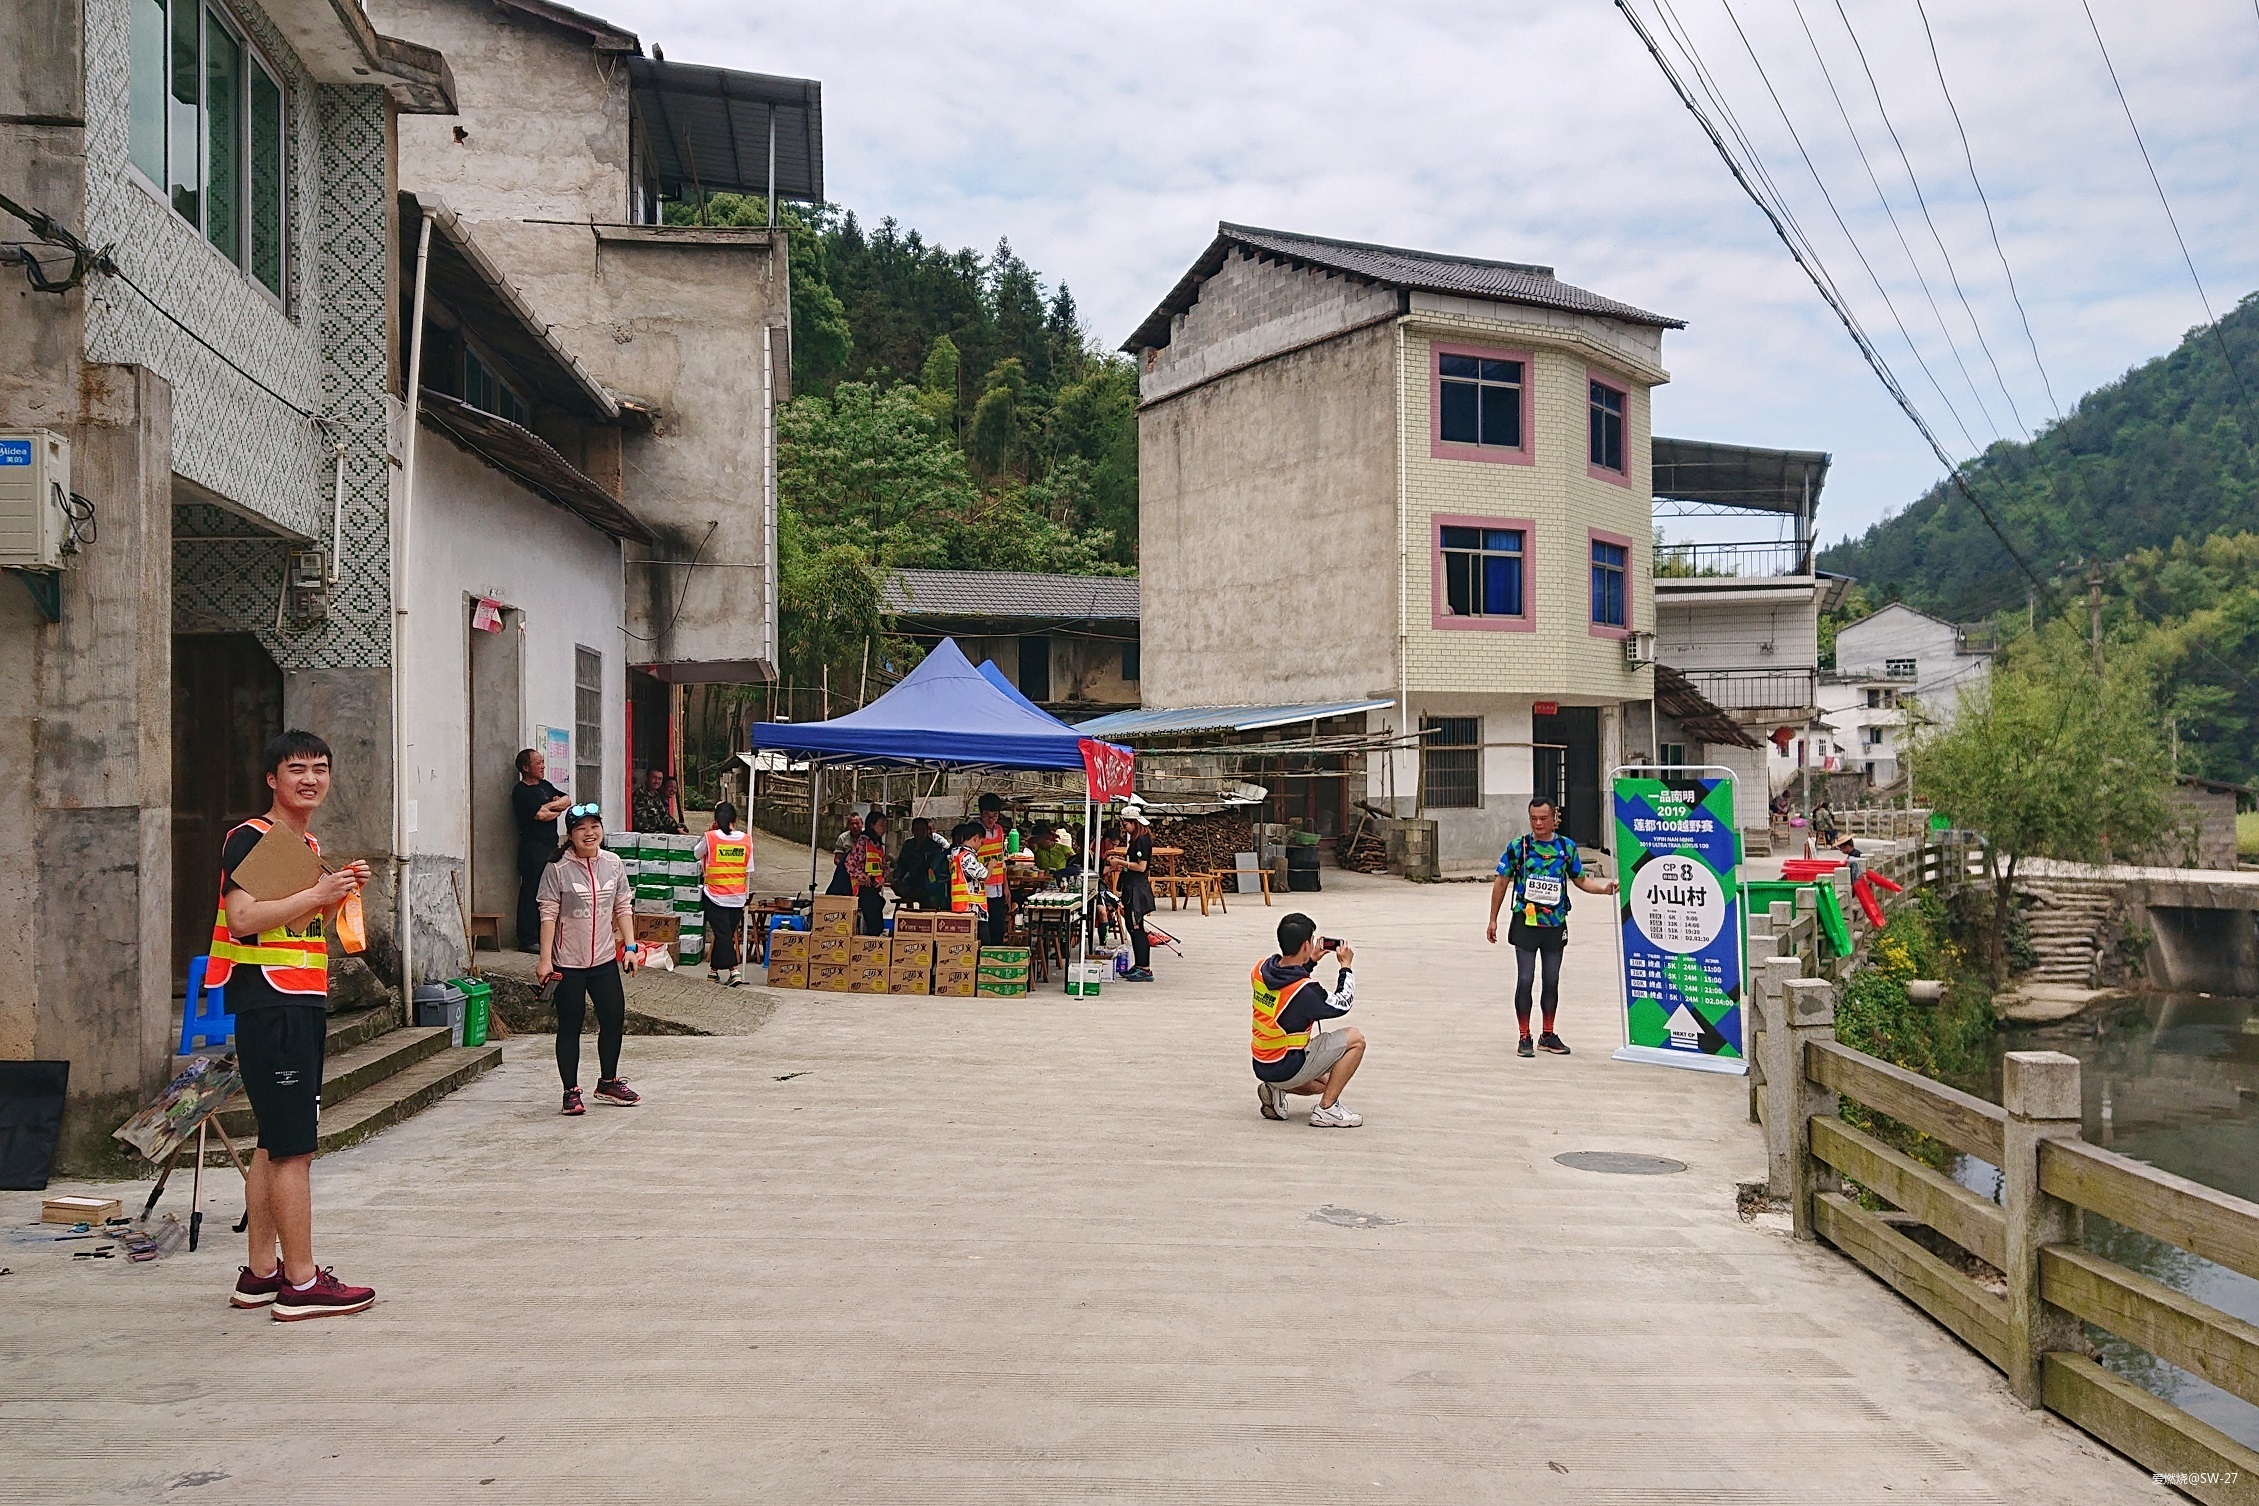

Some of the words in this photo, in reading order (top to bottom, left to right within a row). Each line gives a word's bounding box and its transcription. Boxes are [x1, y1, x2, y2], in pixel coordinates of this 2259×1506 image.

[1647, 790, 1695, 803] 一品南明
[1657, 806, 1686, 816] 2019
[1663, 863, 1676, 871] CP
[1680, 863, 1693, 881] 8
[1529, 881, 1559, 892] B3025
[1647, 885, 1706, 907] 小山村
